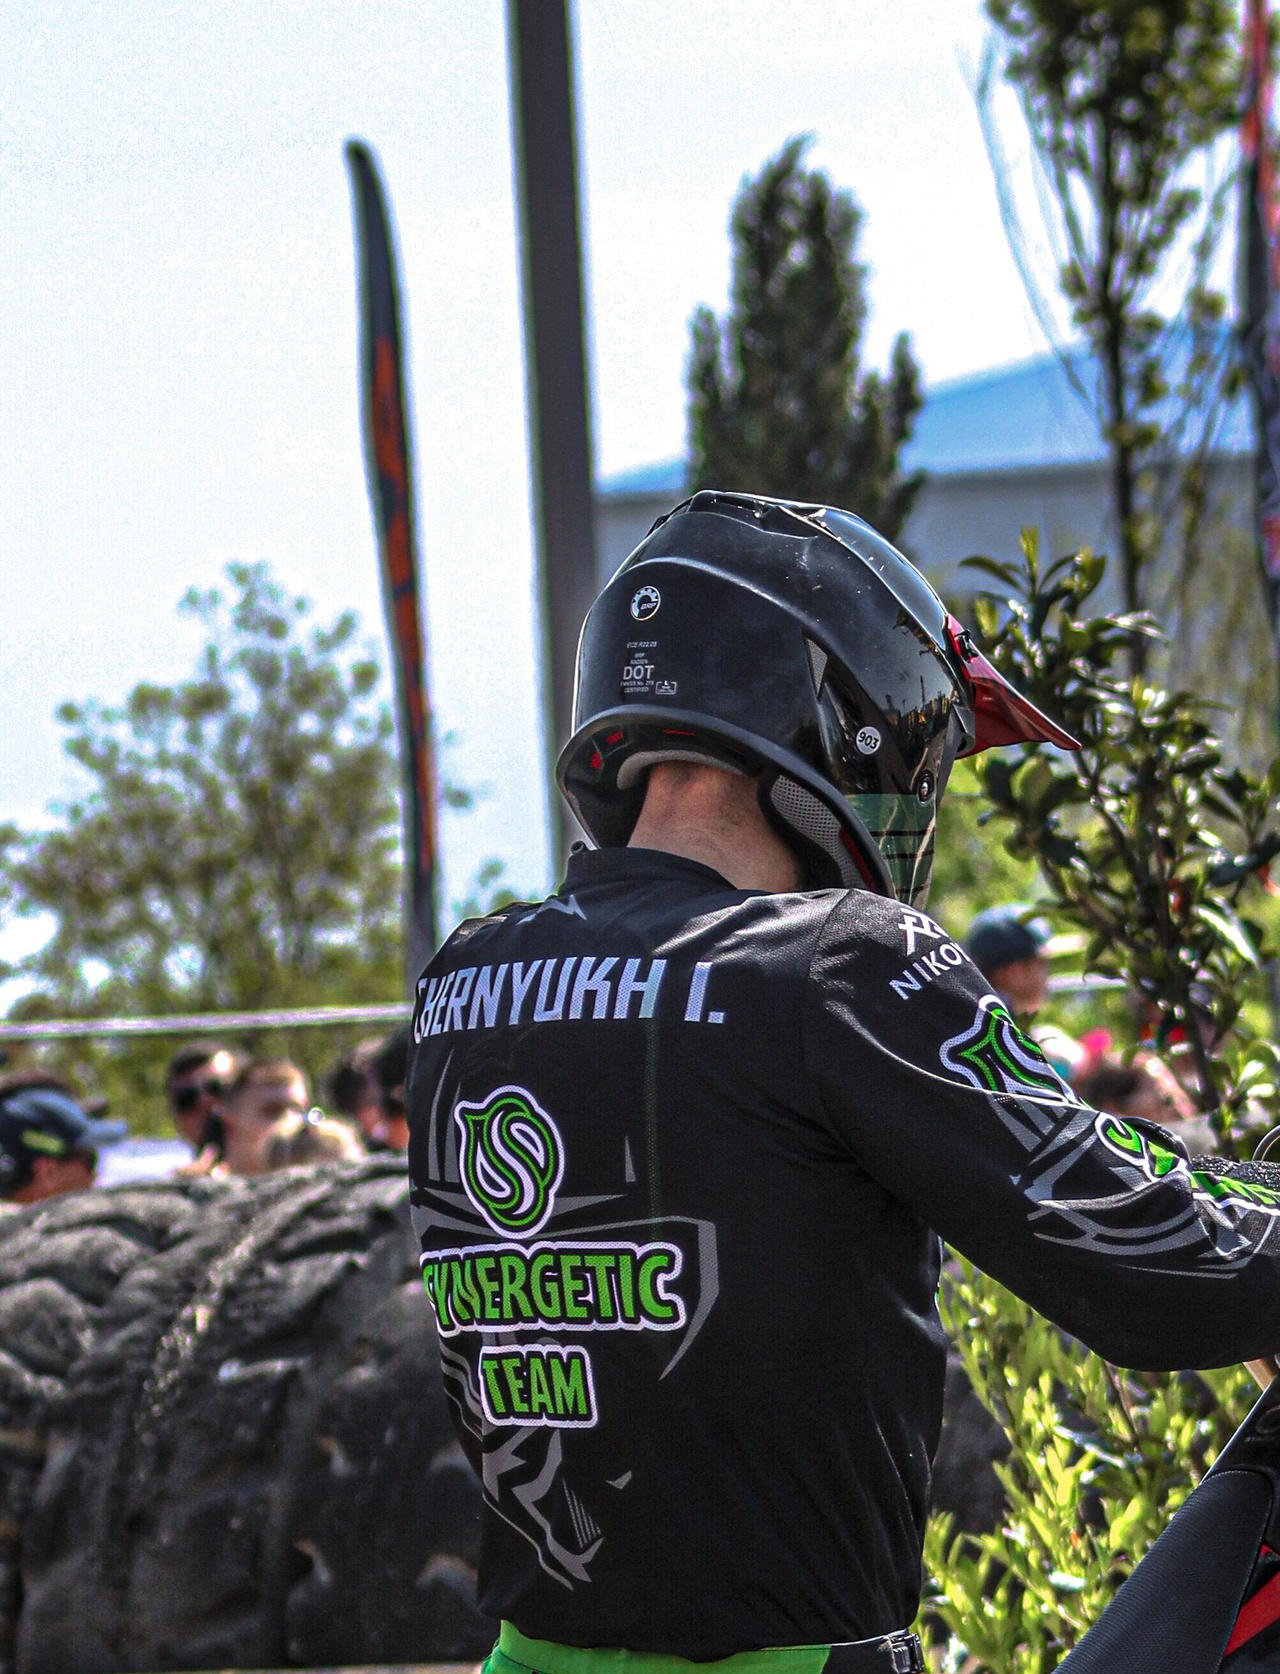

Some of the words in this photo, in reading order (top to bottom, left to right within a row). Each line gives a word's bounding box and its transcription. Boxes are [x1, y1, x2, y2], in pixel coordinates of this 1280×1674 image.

[623, 665, 655, 680] DOT
[858, 731, 879, 749] 903
[413, 956, 668, 1044] CHERNYUKH
[684, 961, 725, 1025] I.
[421, 1249, 679, 1330] SYNERGETIC
[482, 1354, 590, 1418] TEAM
